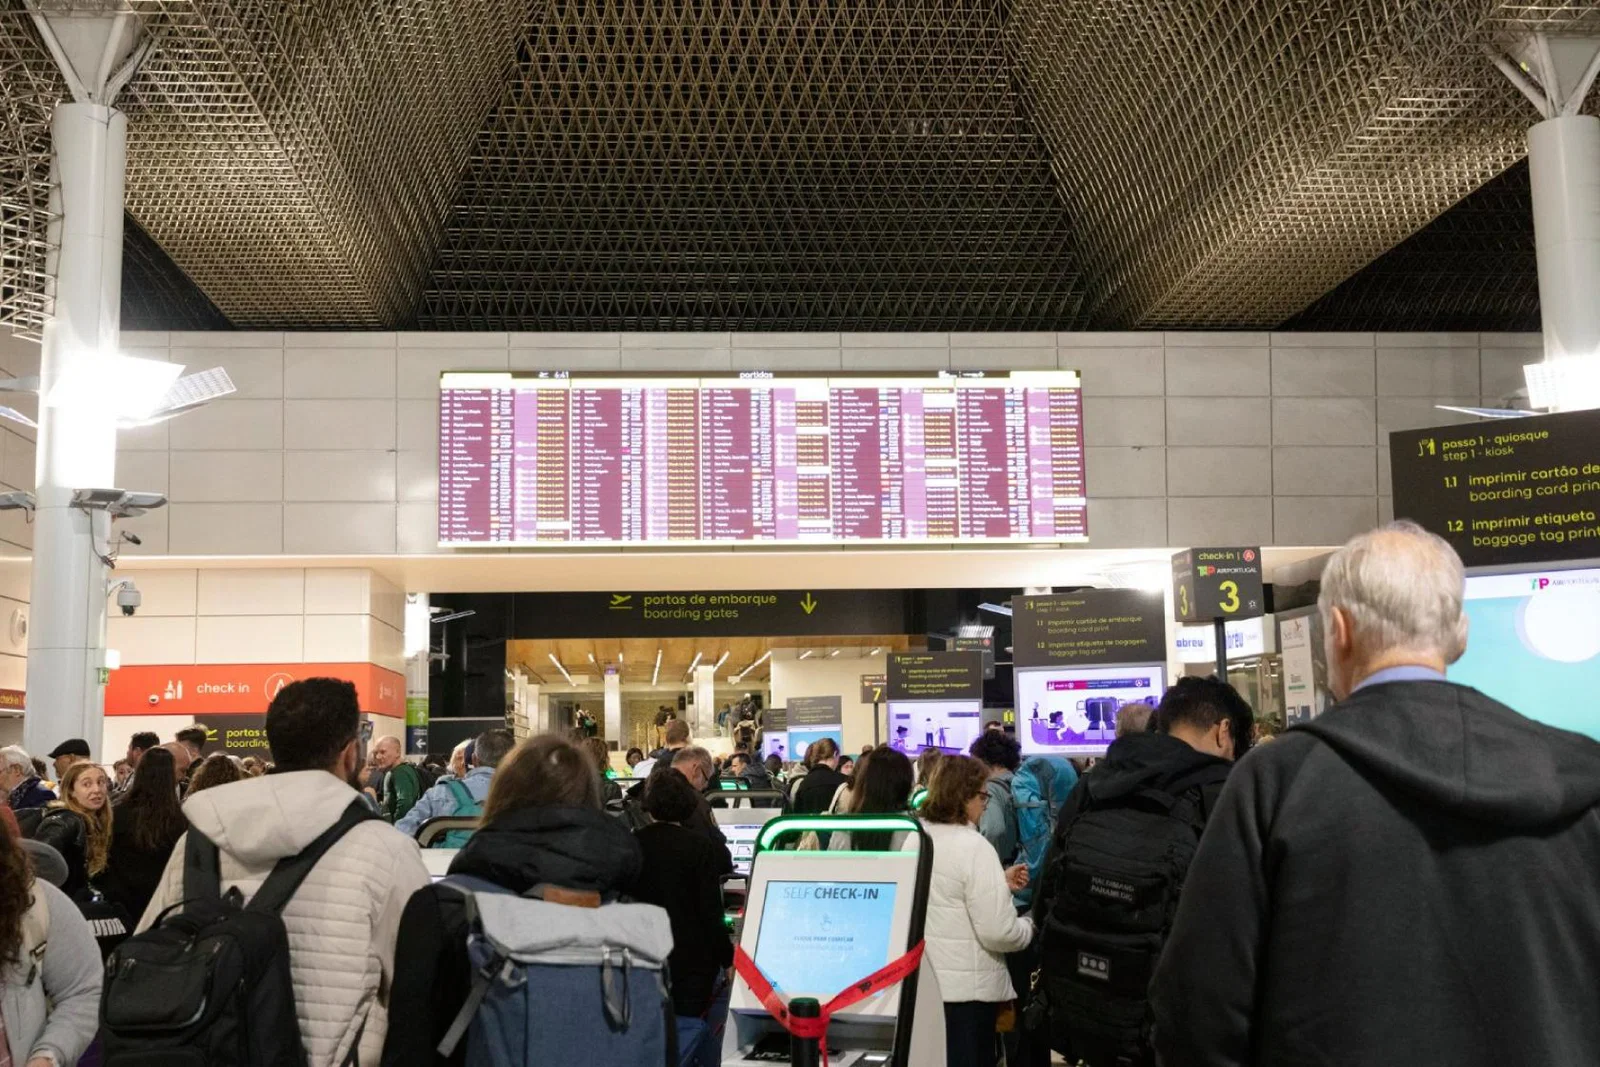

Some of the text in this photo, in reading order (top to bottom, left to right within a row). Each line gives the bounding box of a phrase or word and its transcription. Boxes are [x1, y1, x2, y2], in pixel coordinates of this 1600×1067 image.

[1442, 438, 1476, 450] passo
[1479, 436, 1484, 445] 1
[1494, 430, 1549, 446] quiosque
[1442, 451, 1468, 462] step
[1470, 449, 1475, 458] 1
[1485, 446, 1514, 457] kiosk
[1468, 463, 1600, 486] imprimir cartão de
[1444, 476, 1458, 488] 1.1
[1470, 479, 1600, 502] boarding card prin
[1448, 520, 1464, 532] 1.2
[1472, 510, 1596, 531] imprimir etiqueta
[1473, 526, 1600, 547] baggage tag print
[1198, 552, 1234, 560] check-in
[1198, 566, 1216, 576] TAP
[644, 594, 777, 606] portas de embarque
[1180, 584, 1188, 616] 3
[1220, 580, 1240, 612] 3
[644, 607, 738, 620] boarding gates
[1176, 638, 1204, 648] abreu
[196, 682, 234, 694] check
[238, 682, 250, 693] in
[872, 687, 881, 702] 7
[226, 729, 260, 739] portas
[226, 740, 270, 748] boarding
[784, 887, 879, 900] SELF CHECK-IN
[88, 918, 126, 936] UMA
